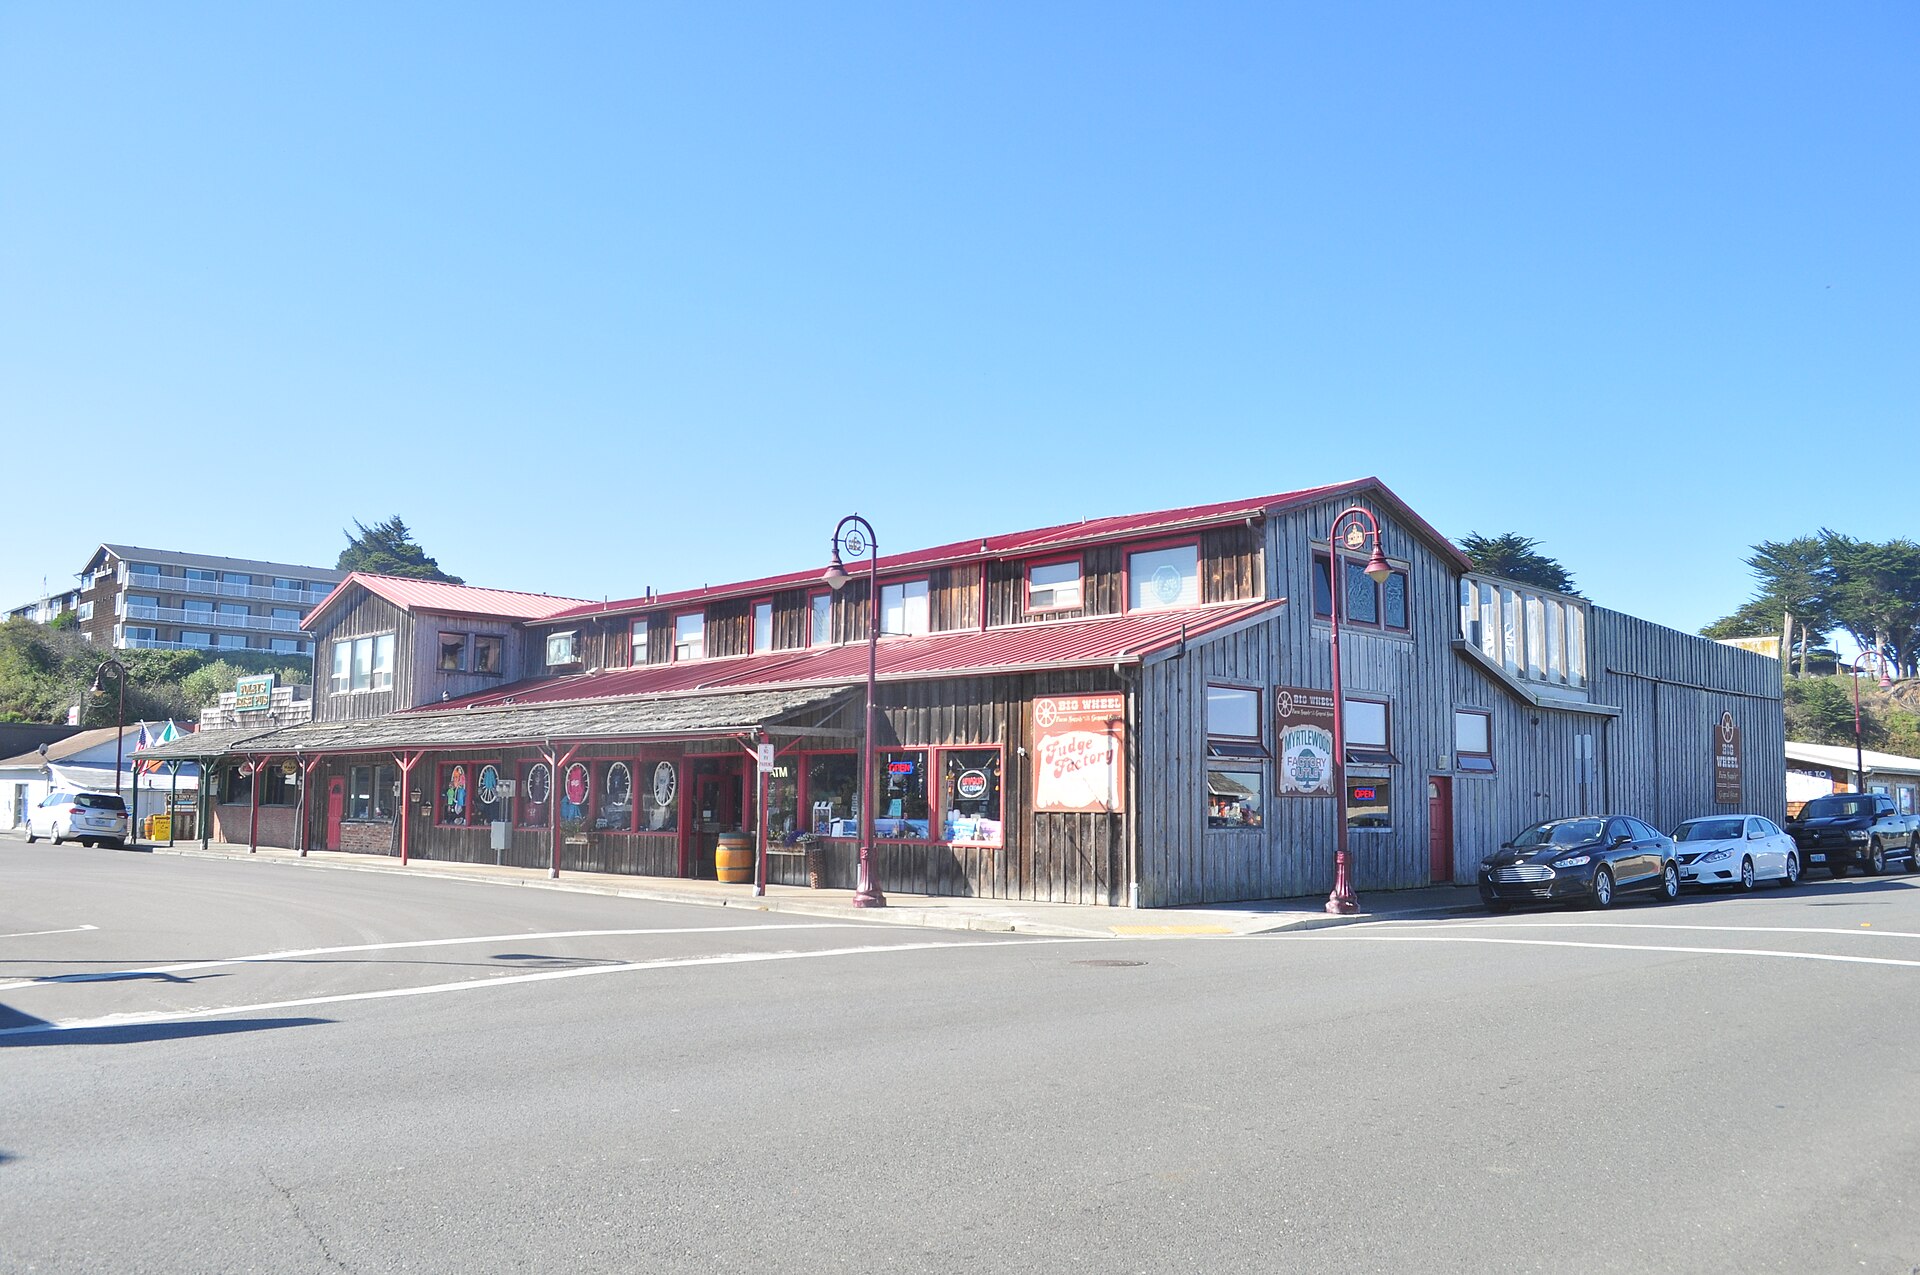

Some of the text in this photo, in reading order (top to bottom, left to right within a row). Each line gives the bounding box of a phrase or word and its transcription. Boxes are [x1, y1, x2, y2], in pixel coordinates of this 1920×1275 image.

[1058, 698, 1121, 711] BIG WHEEL
[1293, 694, 1334, 707] BIG WHEEL
[1285, 730, 1331, 755] MYRTLEWOOD
[1722, 743, 1734, 755] BIG
[1045, 737, 1093, 764] Fudge
[888, 763, 911, 772] OPEN
[1053, 749, 1113, 779] Factory
[1287, 756, 1326, 768] FACTORY
[1716, 755, 1738, 768] WHEEL
[1290, 767, 1324, 778] OUTLET
[1354, 789, 1375, 798] OPEN
